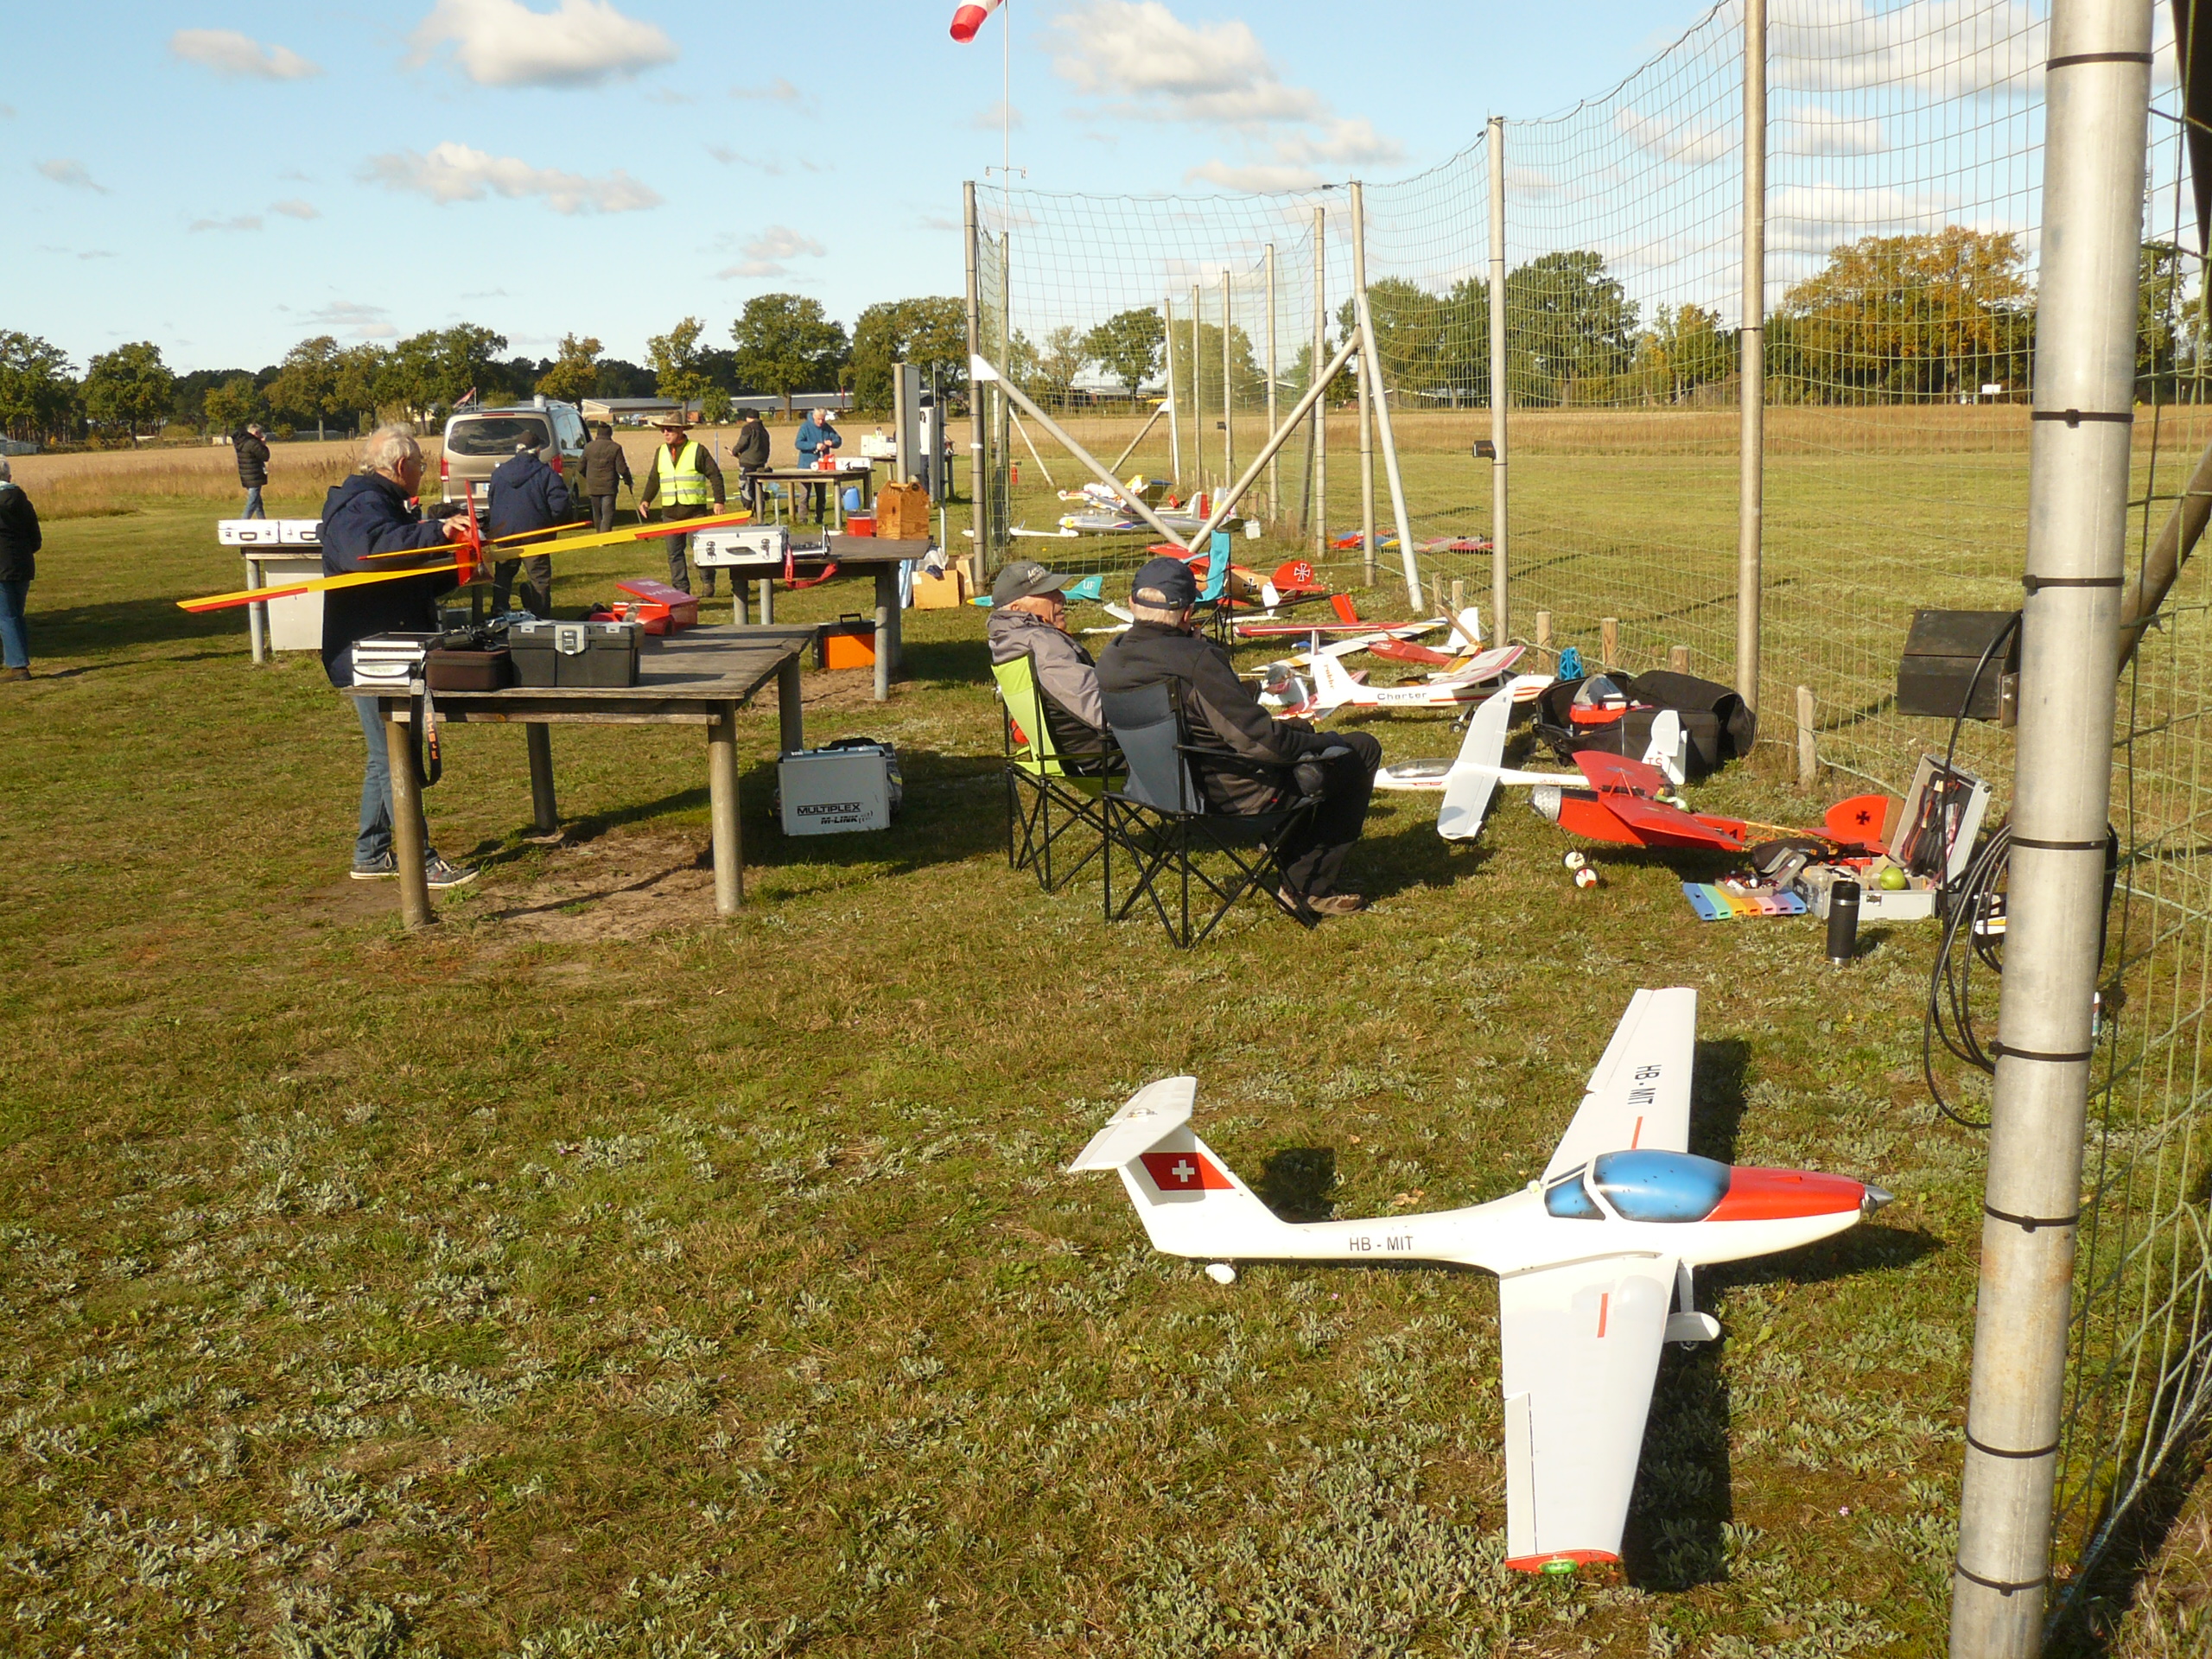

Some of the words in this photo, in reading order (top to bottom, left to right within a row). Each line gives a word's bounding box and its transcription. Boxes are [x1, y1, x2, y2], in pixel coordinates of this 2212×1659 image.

[798, 803, 861, 815] MULTIPLEX
[821, 815, 858, 824] M-LINK
[1634, 1065, 1662, 1080] HB
[1627, 1088, 1656, 1104] MIT
[1350, 1236, 1371, 1251] HB
[1387, 1236, 1413, 1250] MIT
